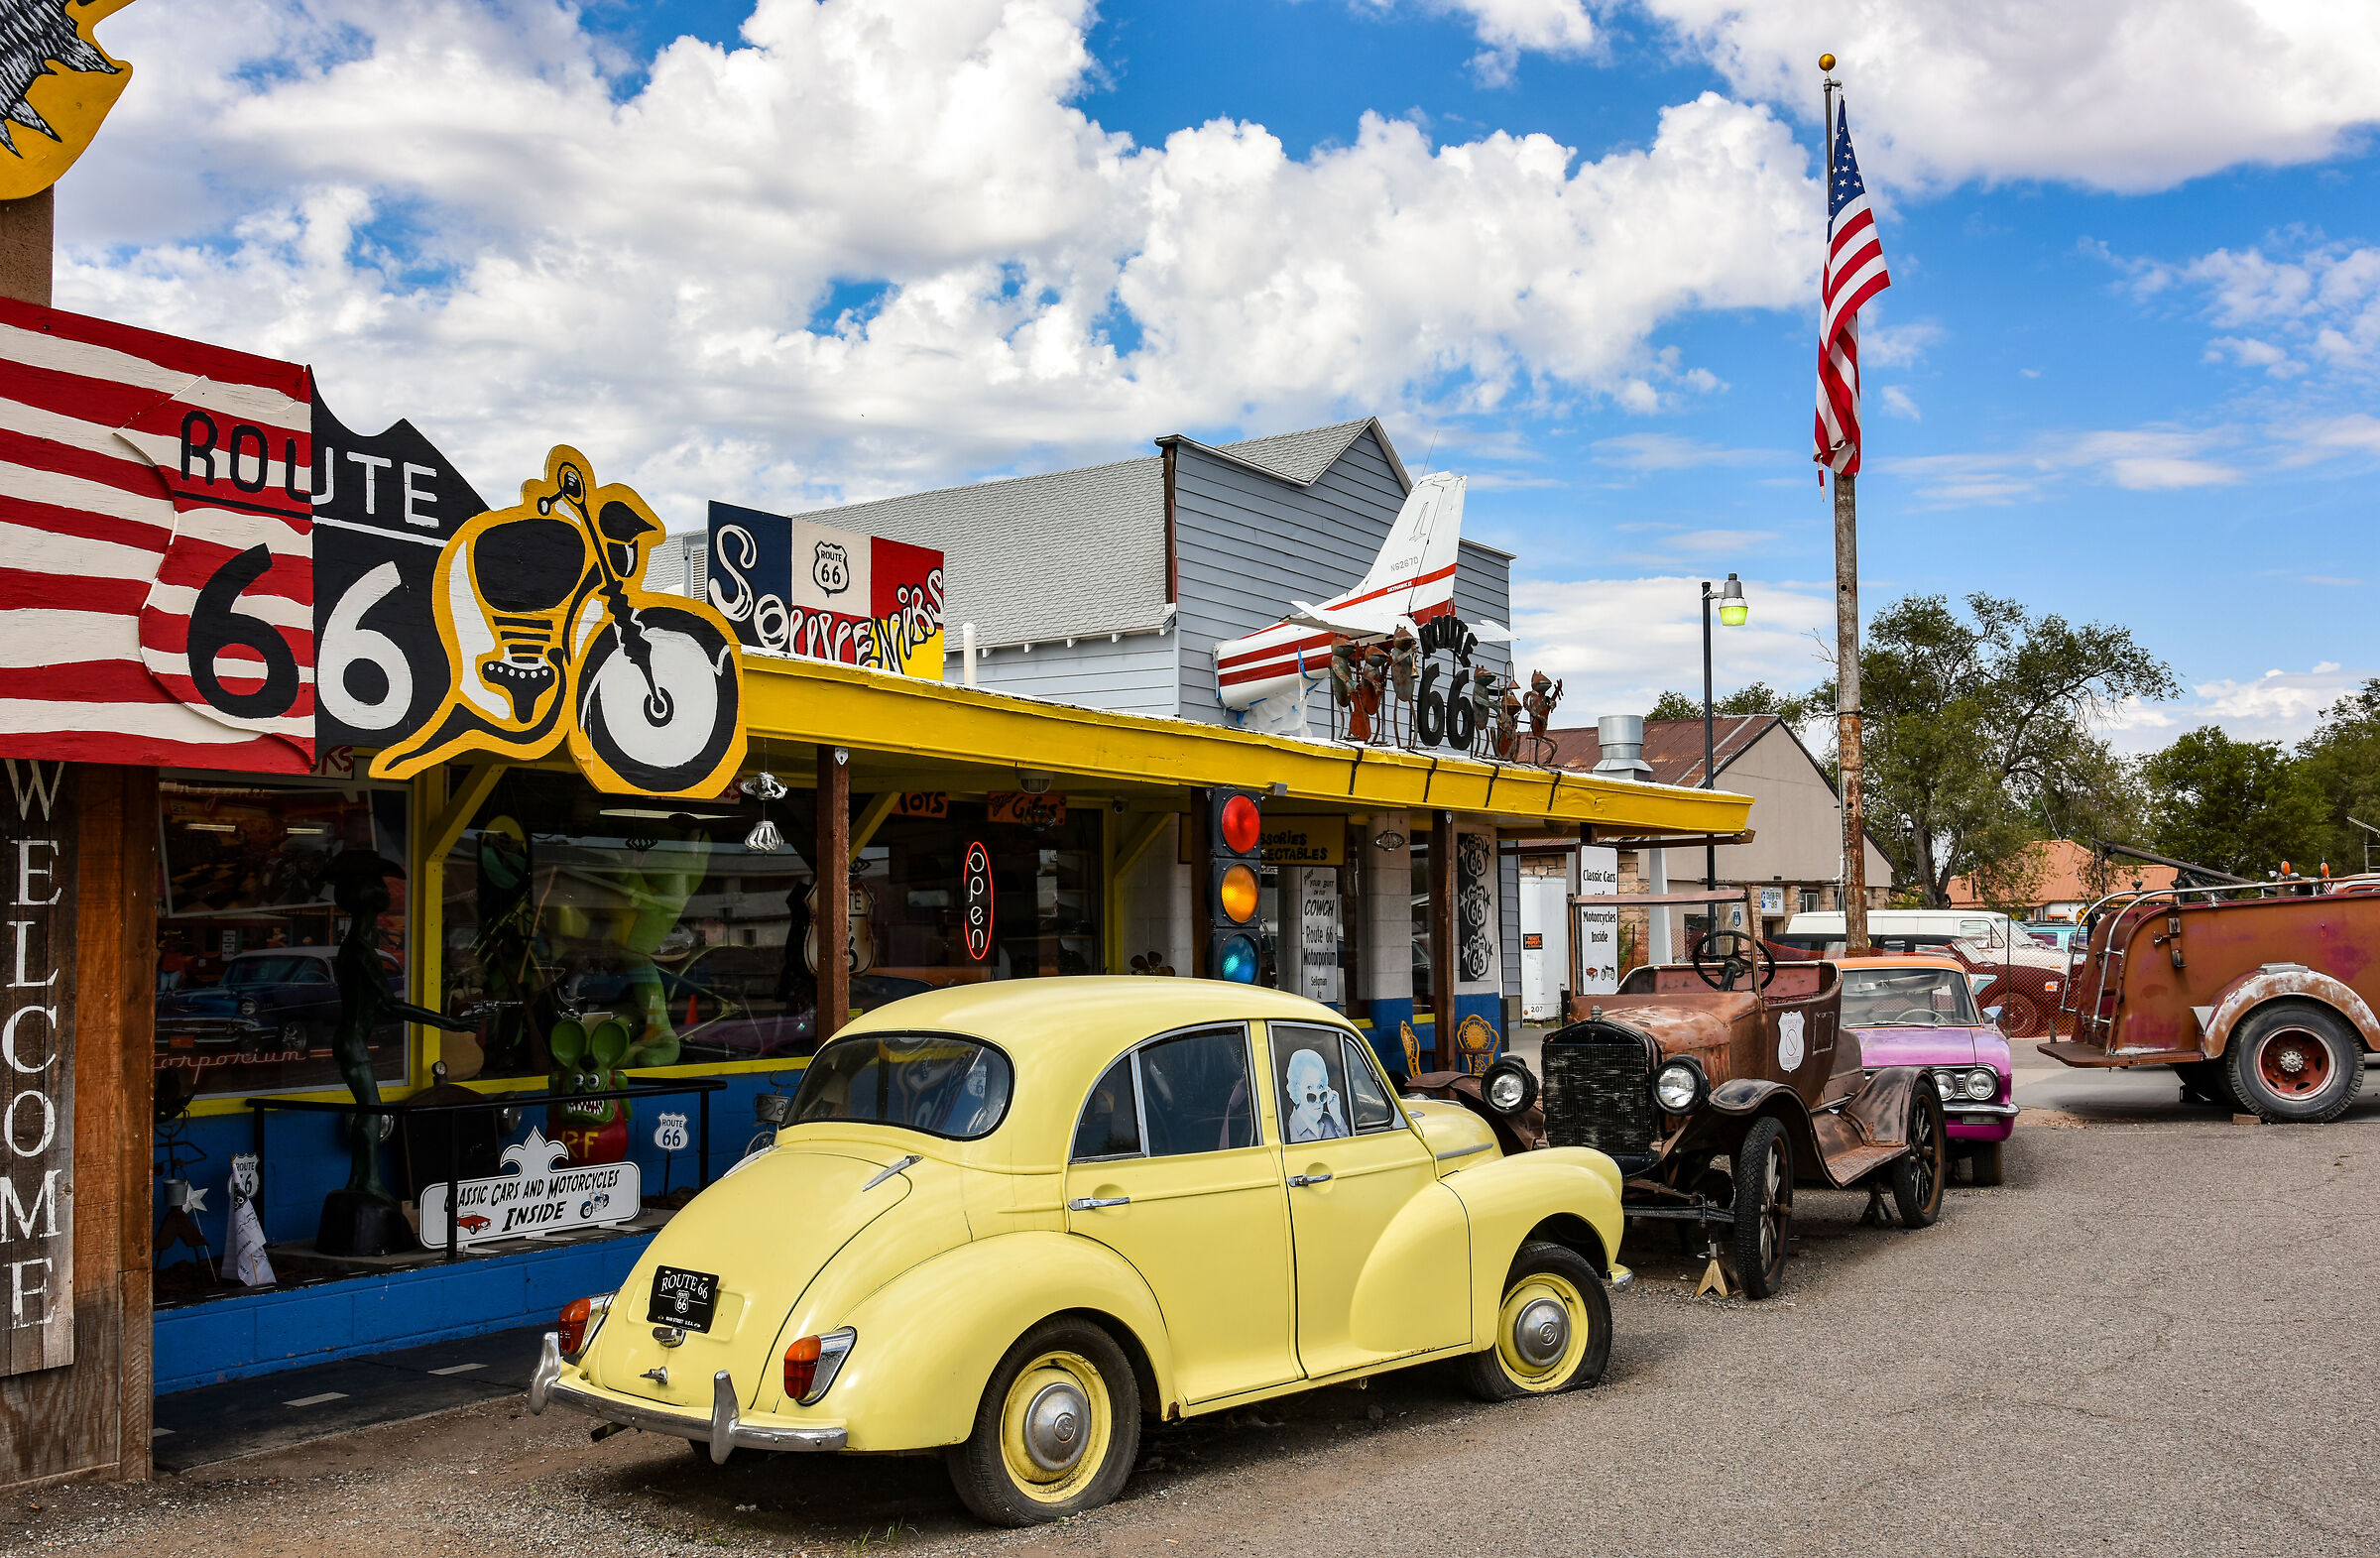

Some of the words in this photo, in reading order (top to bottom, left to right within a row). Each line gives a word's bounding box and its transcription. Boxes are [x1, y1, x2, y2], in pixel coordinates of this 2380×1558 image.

[180, 410, 440, 529] ROUTE
[820, 549, 843, 562] ROUTE
[821, 563, 841, 585] 66
[186, 542, 414, 731] 66
[1418, 615, 1479, 667] ROUTE
[1417, 662, 1475, 751] 66
[1470, 850, 1483, 870] 66
[1583, 869, 1602, 883] Classic
[1603, 870, 1616, 884] Cars
[1471, 902, 1483, 921] 66
[1583, 910, 1616, 926] Motorcycles
[1306, 925, 1324, 944] Route
[1325, 925, 1334, 944] 66
[1591, 931, 1608, 943] Inside
[1303, 948, 1337, 971] Motorporium
[1472, 951, 1485, 971] 66
[0, 759, 65, 1330] WELCOME
[661, 1119, 683, 1128] ROUTE
[662, 1128, 681, 1147] 66
[491, 1181, 521, 1206] CARS
[523, 1179, 544, 1199] AND
[547, 1169, 621, 1199] MOTORCYCLES
[502, 1200, 567, 1232] INSIDE
[660, 1273, 699, 1292] ROUTE
[697, 1282, 709, 1300] 66
[676, 1298, 687, 1311] 66
